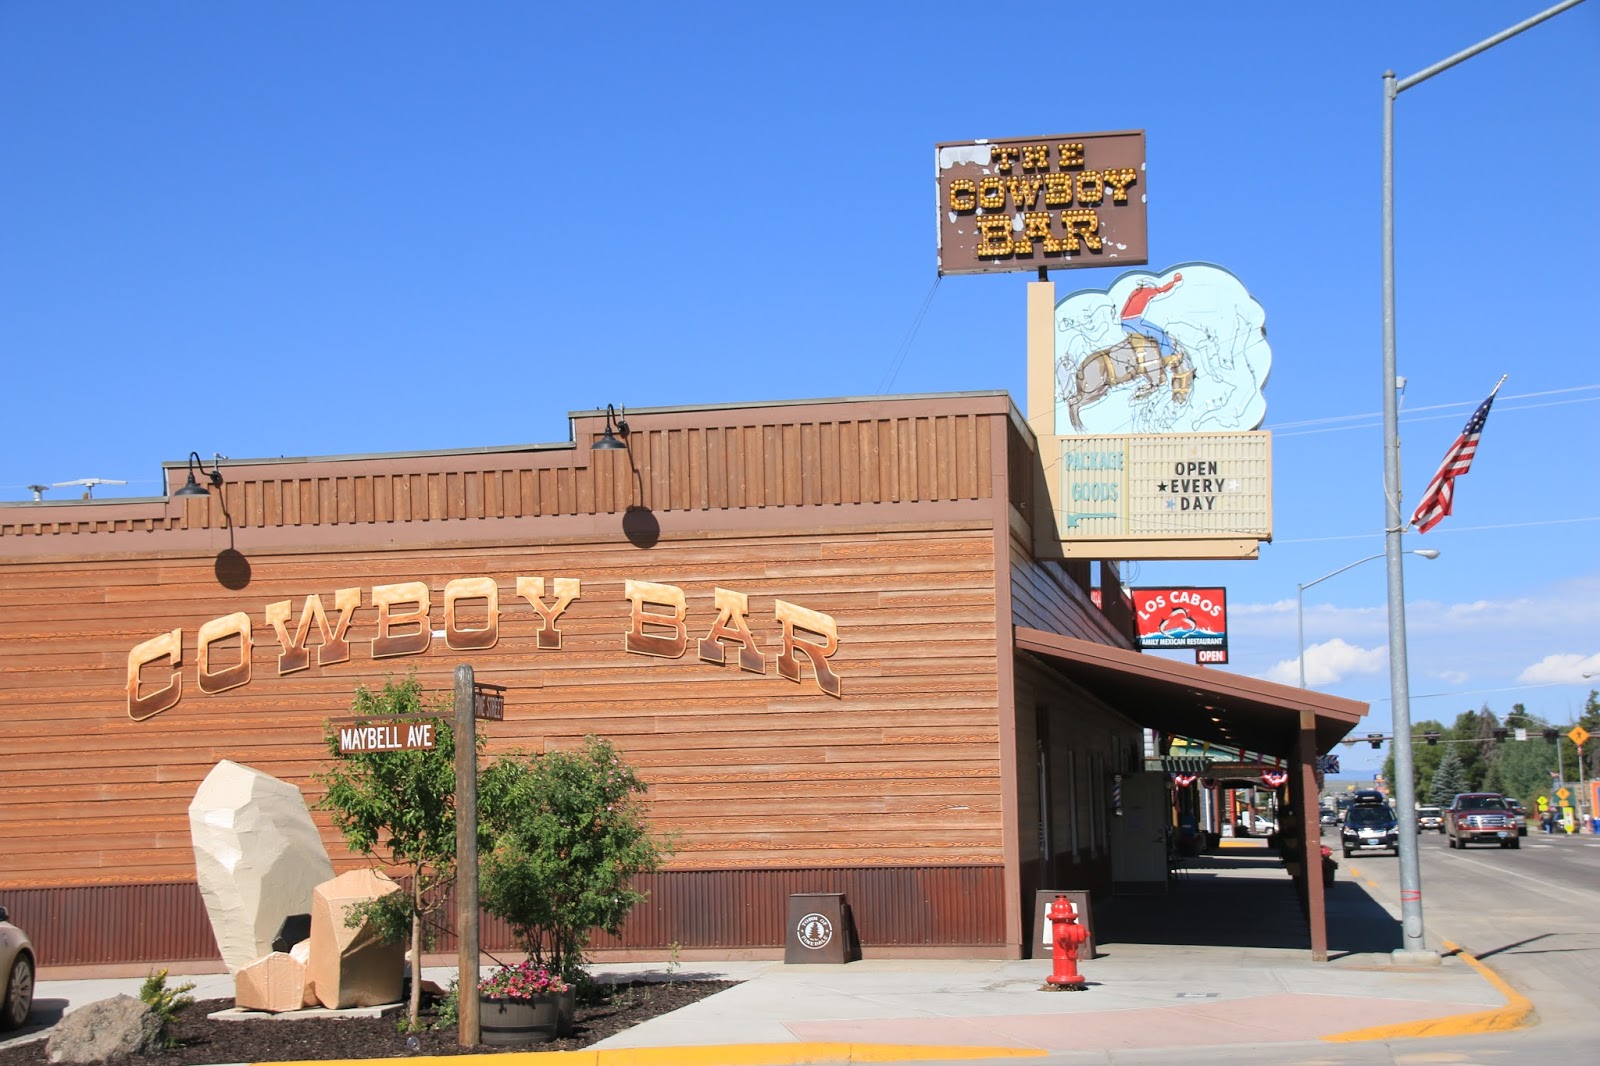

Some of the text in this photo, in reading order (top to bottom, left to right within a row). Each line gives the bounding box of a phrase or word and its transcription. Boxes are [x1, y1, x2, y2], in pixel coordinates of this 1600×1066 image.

[991, 143, 1085, 171] THE
[949, 168, 1137, 211] COWBOY
[976, 209, 1103, 258] BAR
[1065, 451, 1124, 471] PACKAGE
[1174, 461, 1218, 476] OPEN
[1072, 482, 1119, 501] GOODS
[1170, 478, 1225, 493] EVERY
[1180, 496, 1215, 511] DAY
[1138, 591, 1222, 620] LOS CABOS
[125, 577, 842, 722] COWBOY BAR
[1140, 638, 1222, 646] AMILY MEXICAN RESTAURANT
[1199, 650, 1223, 662] OPEN
[341, 724, 432, 750] MAYBELL AVE
[802, 916, 828, 927] TOWN OF
[801, 935, 828, 947] PINEDALE
